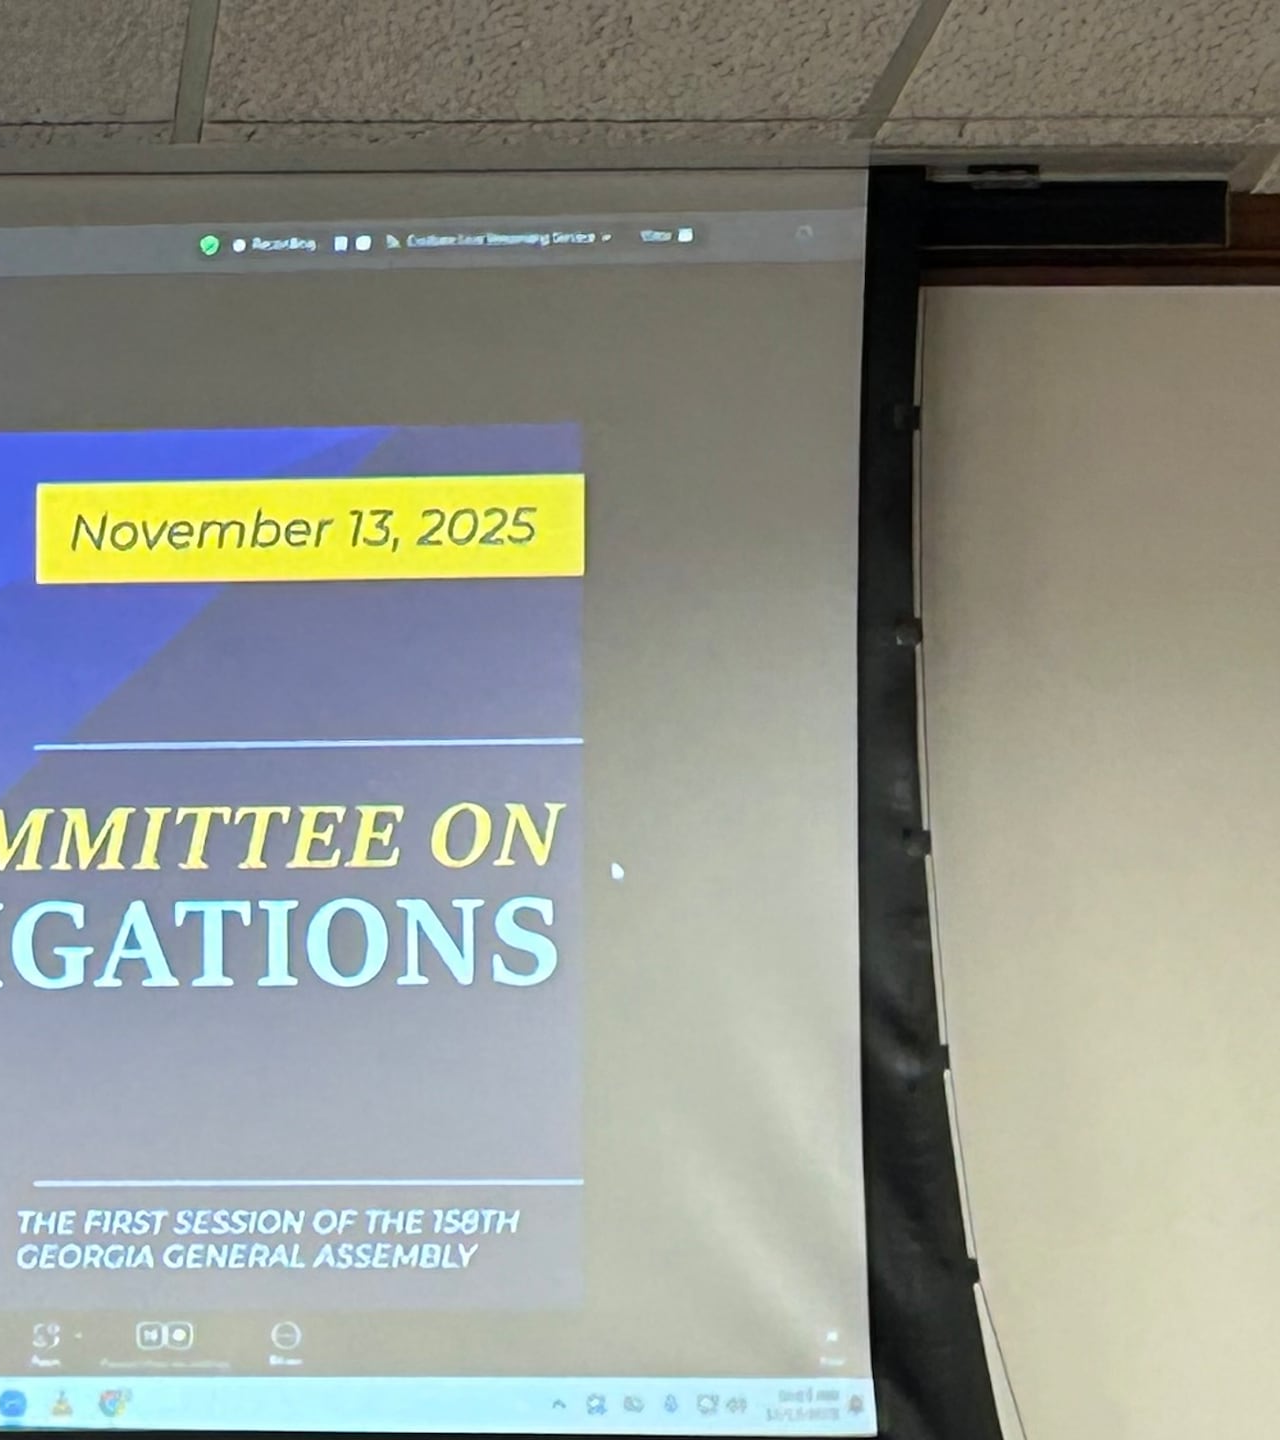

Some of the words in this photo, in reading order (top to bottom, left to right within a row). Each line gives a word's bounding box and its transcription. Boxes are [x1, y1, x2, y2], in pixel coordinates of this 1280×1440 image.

[70, 508, 334, 552] November
[348, 508, 397, 553] 13,
[415, 507, 538, 546] 2025
[430, 802, 567, 868] ON
[17, 1209, 76, 1235] THE
[83, 1209, 168, 1235] FIRST
[172, 1208, 306, 1236] SESSION
[311, 1209, 357, 1235] OF
[364, 1208, 426, 1235] THE
[432, 1208, 522, 1235] 158TH
[16, 1243, 155, 1270] GEORGIA
[162, 1243, 307, 1269] GENERAL
[312, 1242, 480, 1270] ASSEMBLY
